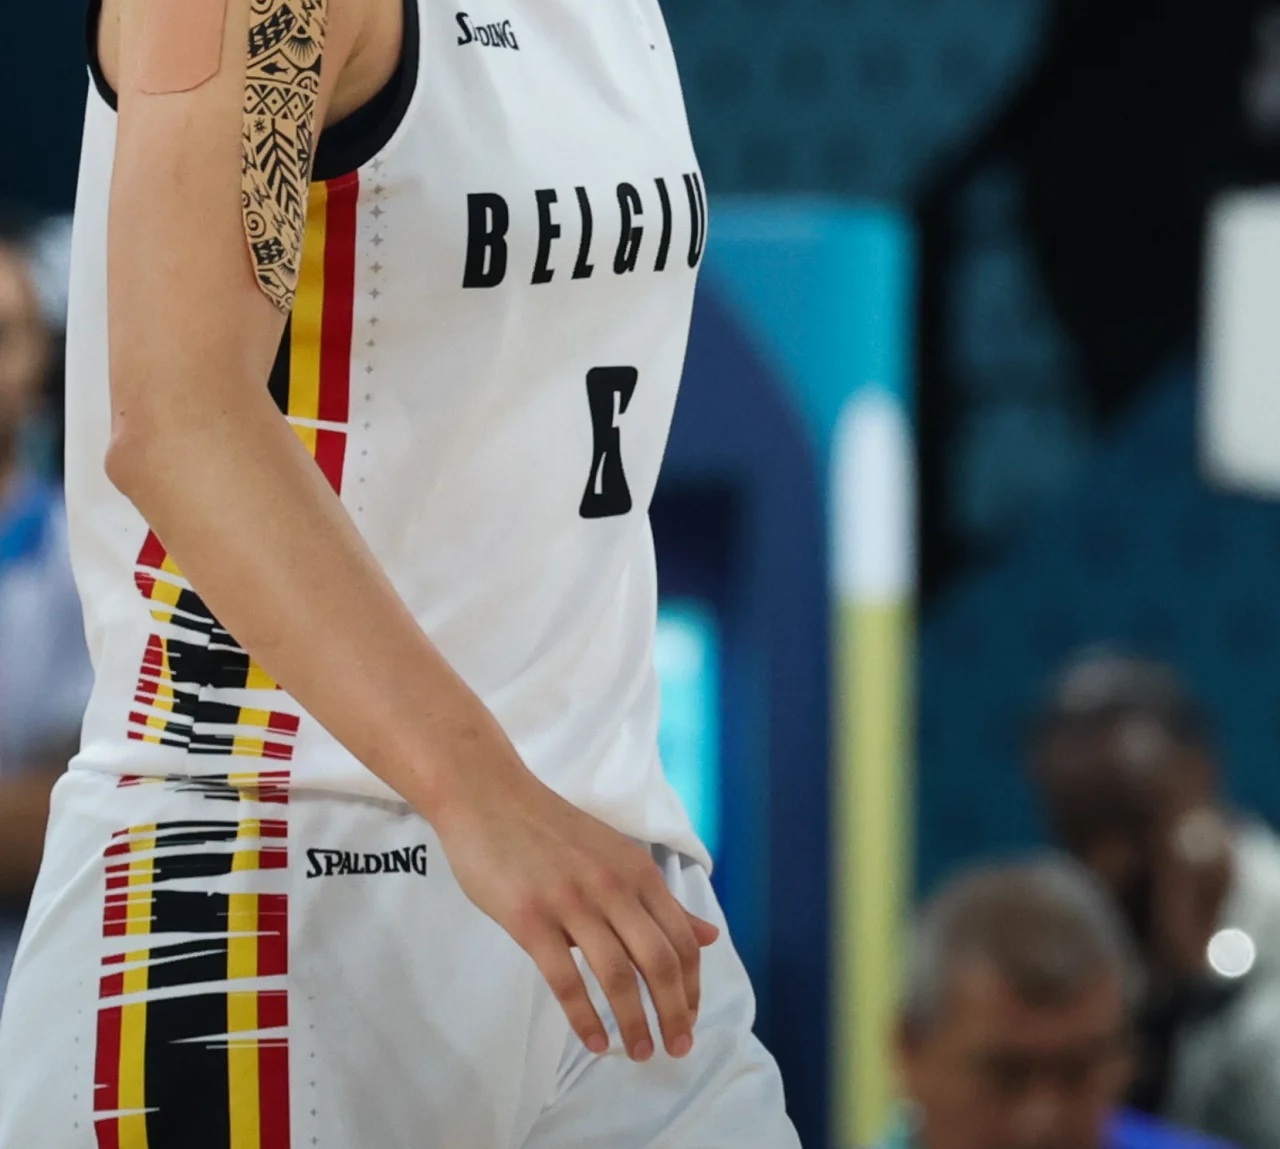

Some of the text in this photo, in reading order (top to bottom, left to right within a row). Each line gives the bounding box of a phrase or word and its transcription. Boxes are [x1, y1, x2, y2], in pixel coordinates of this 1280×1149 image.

[462, 172, 705, 288] BELGIU
[579, 365, 638, 519] 6
[306, 844, 427, 878] SPALDING
